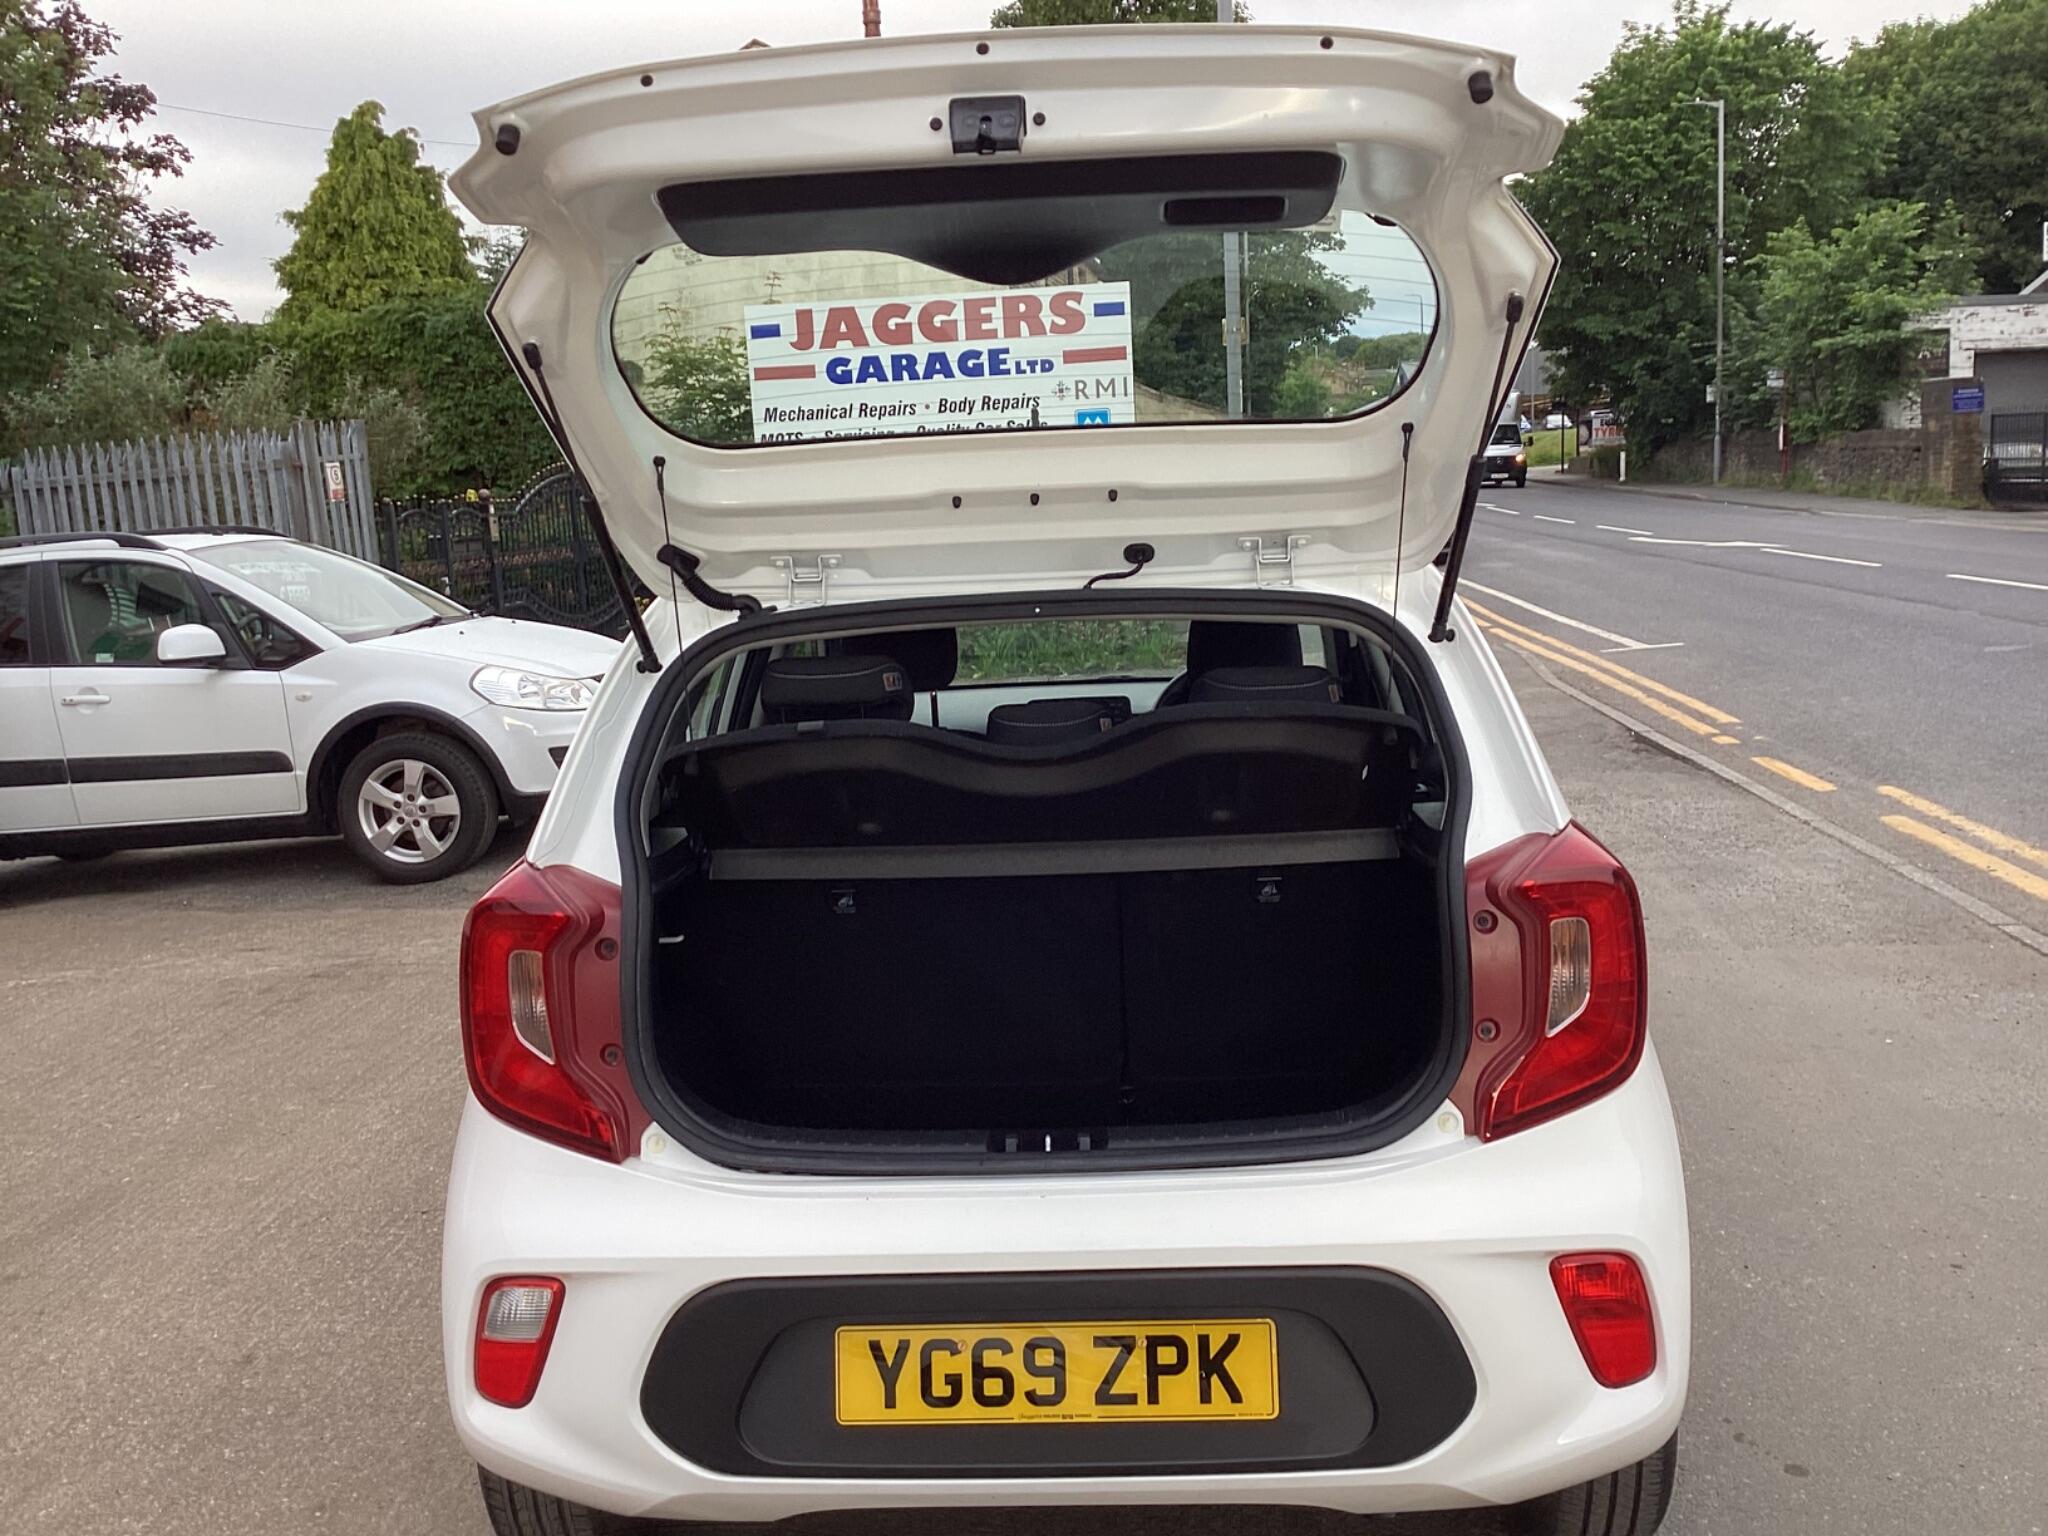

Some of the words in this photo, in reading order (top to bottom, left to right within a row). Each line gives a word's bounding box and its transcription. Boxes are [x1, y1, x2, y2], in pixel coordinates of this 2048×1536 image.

[790, 291, 1086, 351] JAGGERS
[826, 347, 1011, 385] GARAGE
[1015, 358, 1055, 375] LTD
[1074, 376, 1129, 401] RMI
[764, 403, 853, 423] Mechanical
[858, 400, 917, 420] Repairs
[938, 396, 976, 415] Body
[981, 393, 1041, 413] Repairs
[869, 1337, 1067, 1409] YG69
[1093, 1333, 1244, 1406] ZPK
